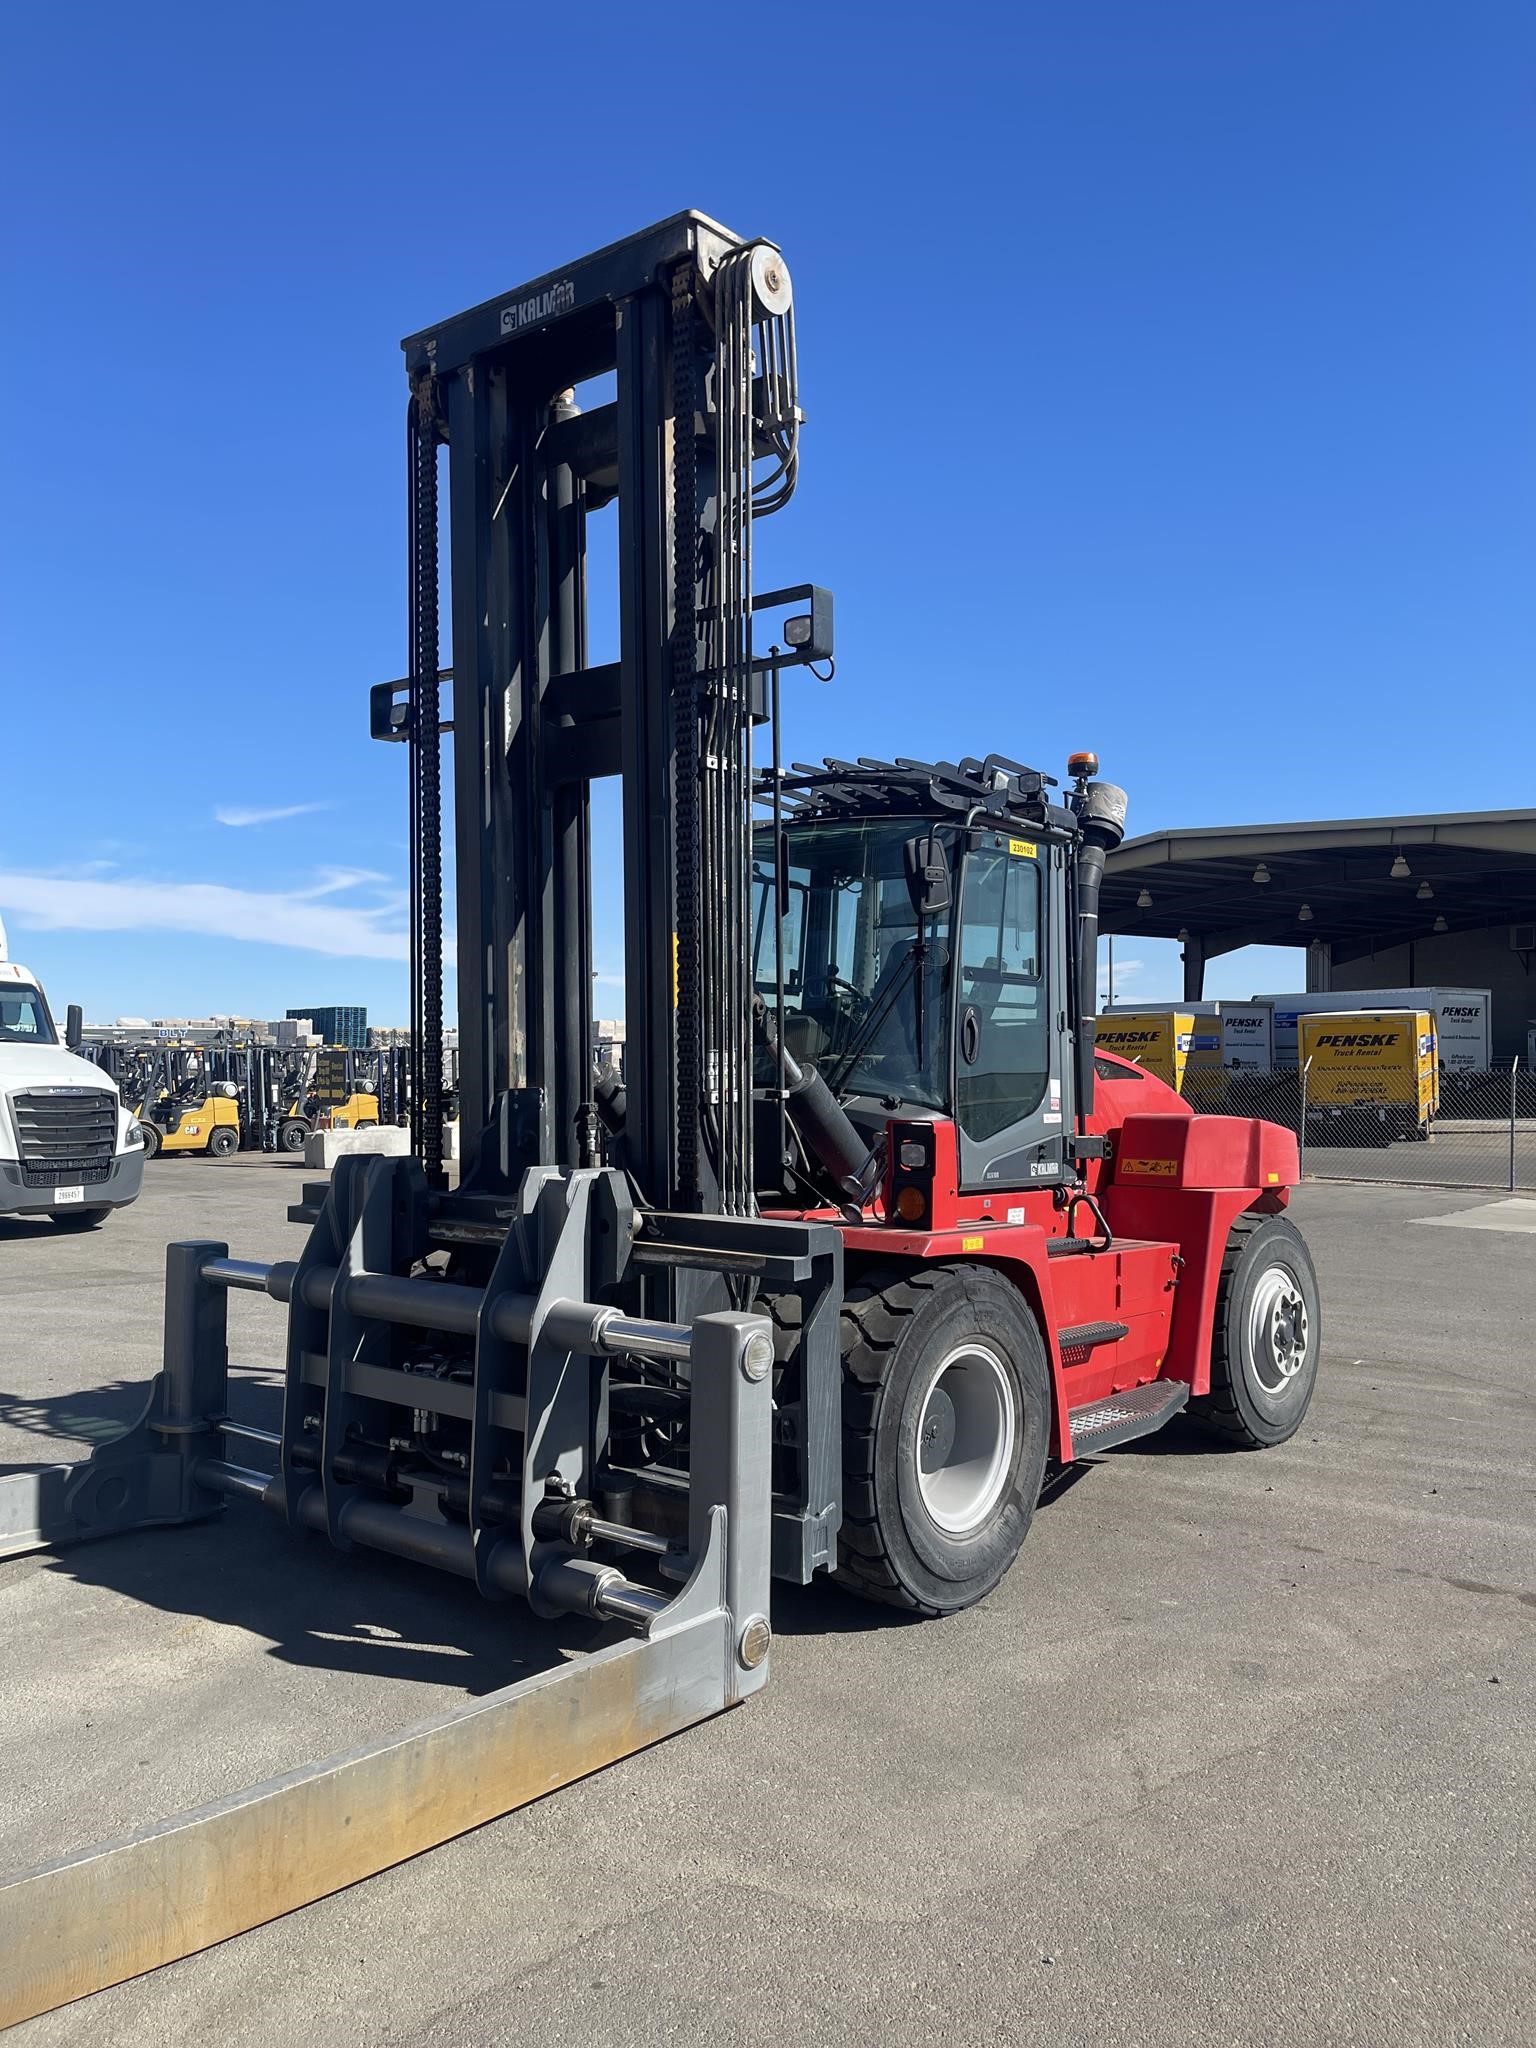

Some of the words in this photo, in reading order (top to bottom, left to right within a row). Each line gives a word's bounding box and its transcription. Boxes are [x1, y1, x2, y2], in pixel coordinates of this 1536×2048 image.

[518, 280, 575, 326] KALMAR
[1442, 1007, 1481, 1017] PENSKE
[1225, 1018, 1265, 1028] PENSKE
[159, 1028, 187, 1037] BLY
[1095, 1031, 1161, 1044] PENSKE
[1316, 1034, 1401, 1048] PENSKE
[1333, 1049, 1354, 1057] Truck
[185, 1126, 199, 1135] CAT
